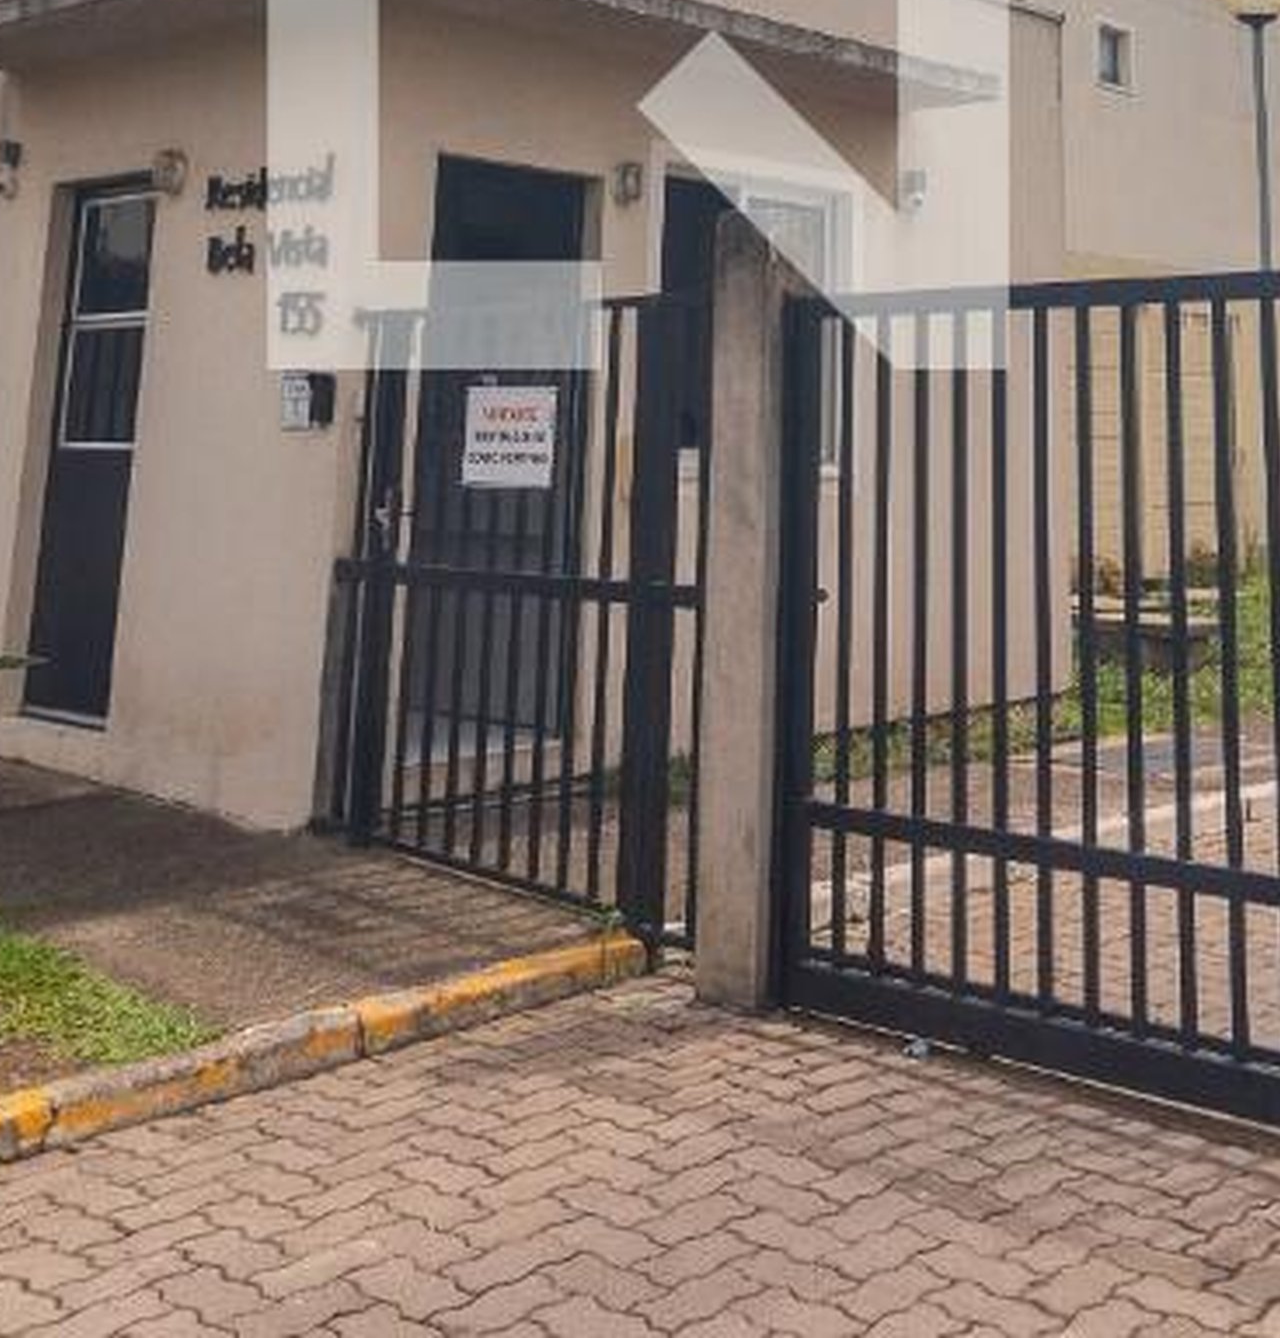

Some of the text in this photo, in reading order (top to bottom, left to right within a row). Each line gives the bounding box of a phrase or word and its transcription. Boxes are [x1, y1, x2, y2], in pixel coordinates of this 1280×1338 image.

[204, 150, 336, 212] Residencial
[206, 224, 329, 275] Bela Vista
